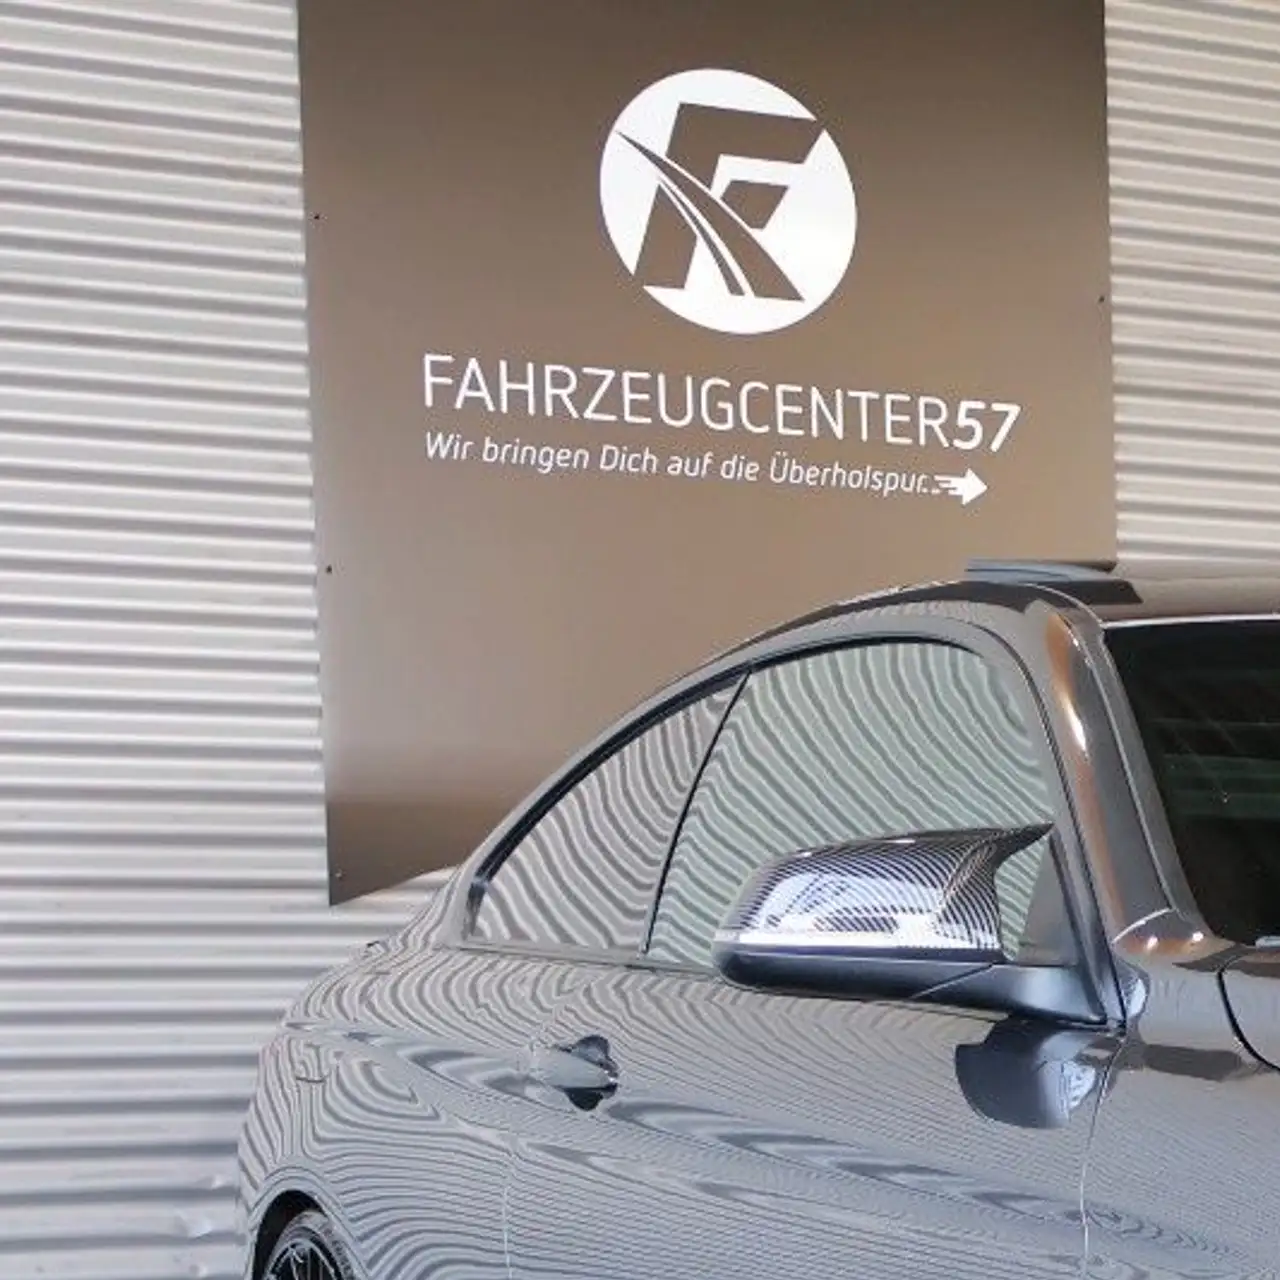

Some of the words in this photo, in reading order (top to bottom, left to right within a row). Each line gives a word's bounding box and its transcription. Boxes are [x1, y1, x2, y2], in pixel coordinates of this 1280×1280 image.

[422, 353, 1022, 453] FAHRZEUGCENTER57
[425, 431, 474, 461] Wir
[482, 436, 590, 475] bringen
[599, 443, 658, 474] Dich
[666, 451, 714, 478] auf
[720, 454, 760, 482] die
